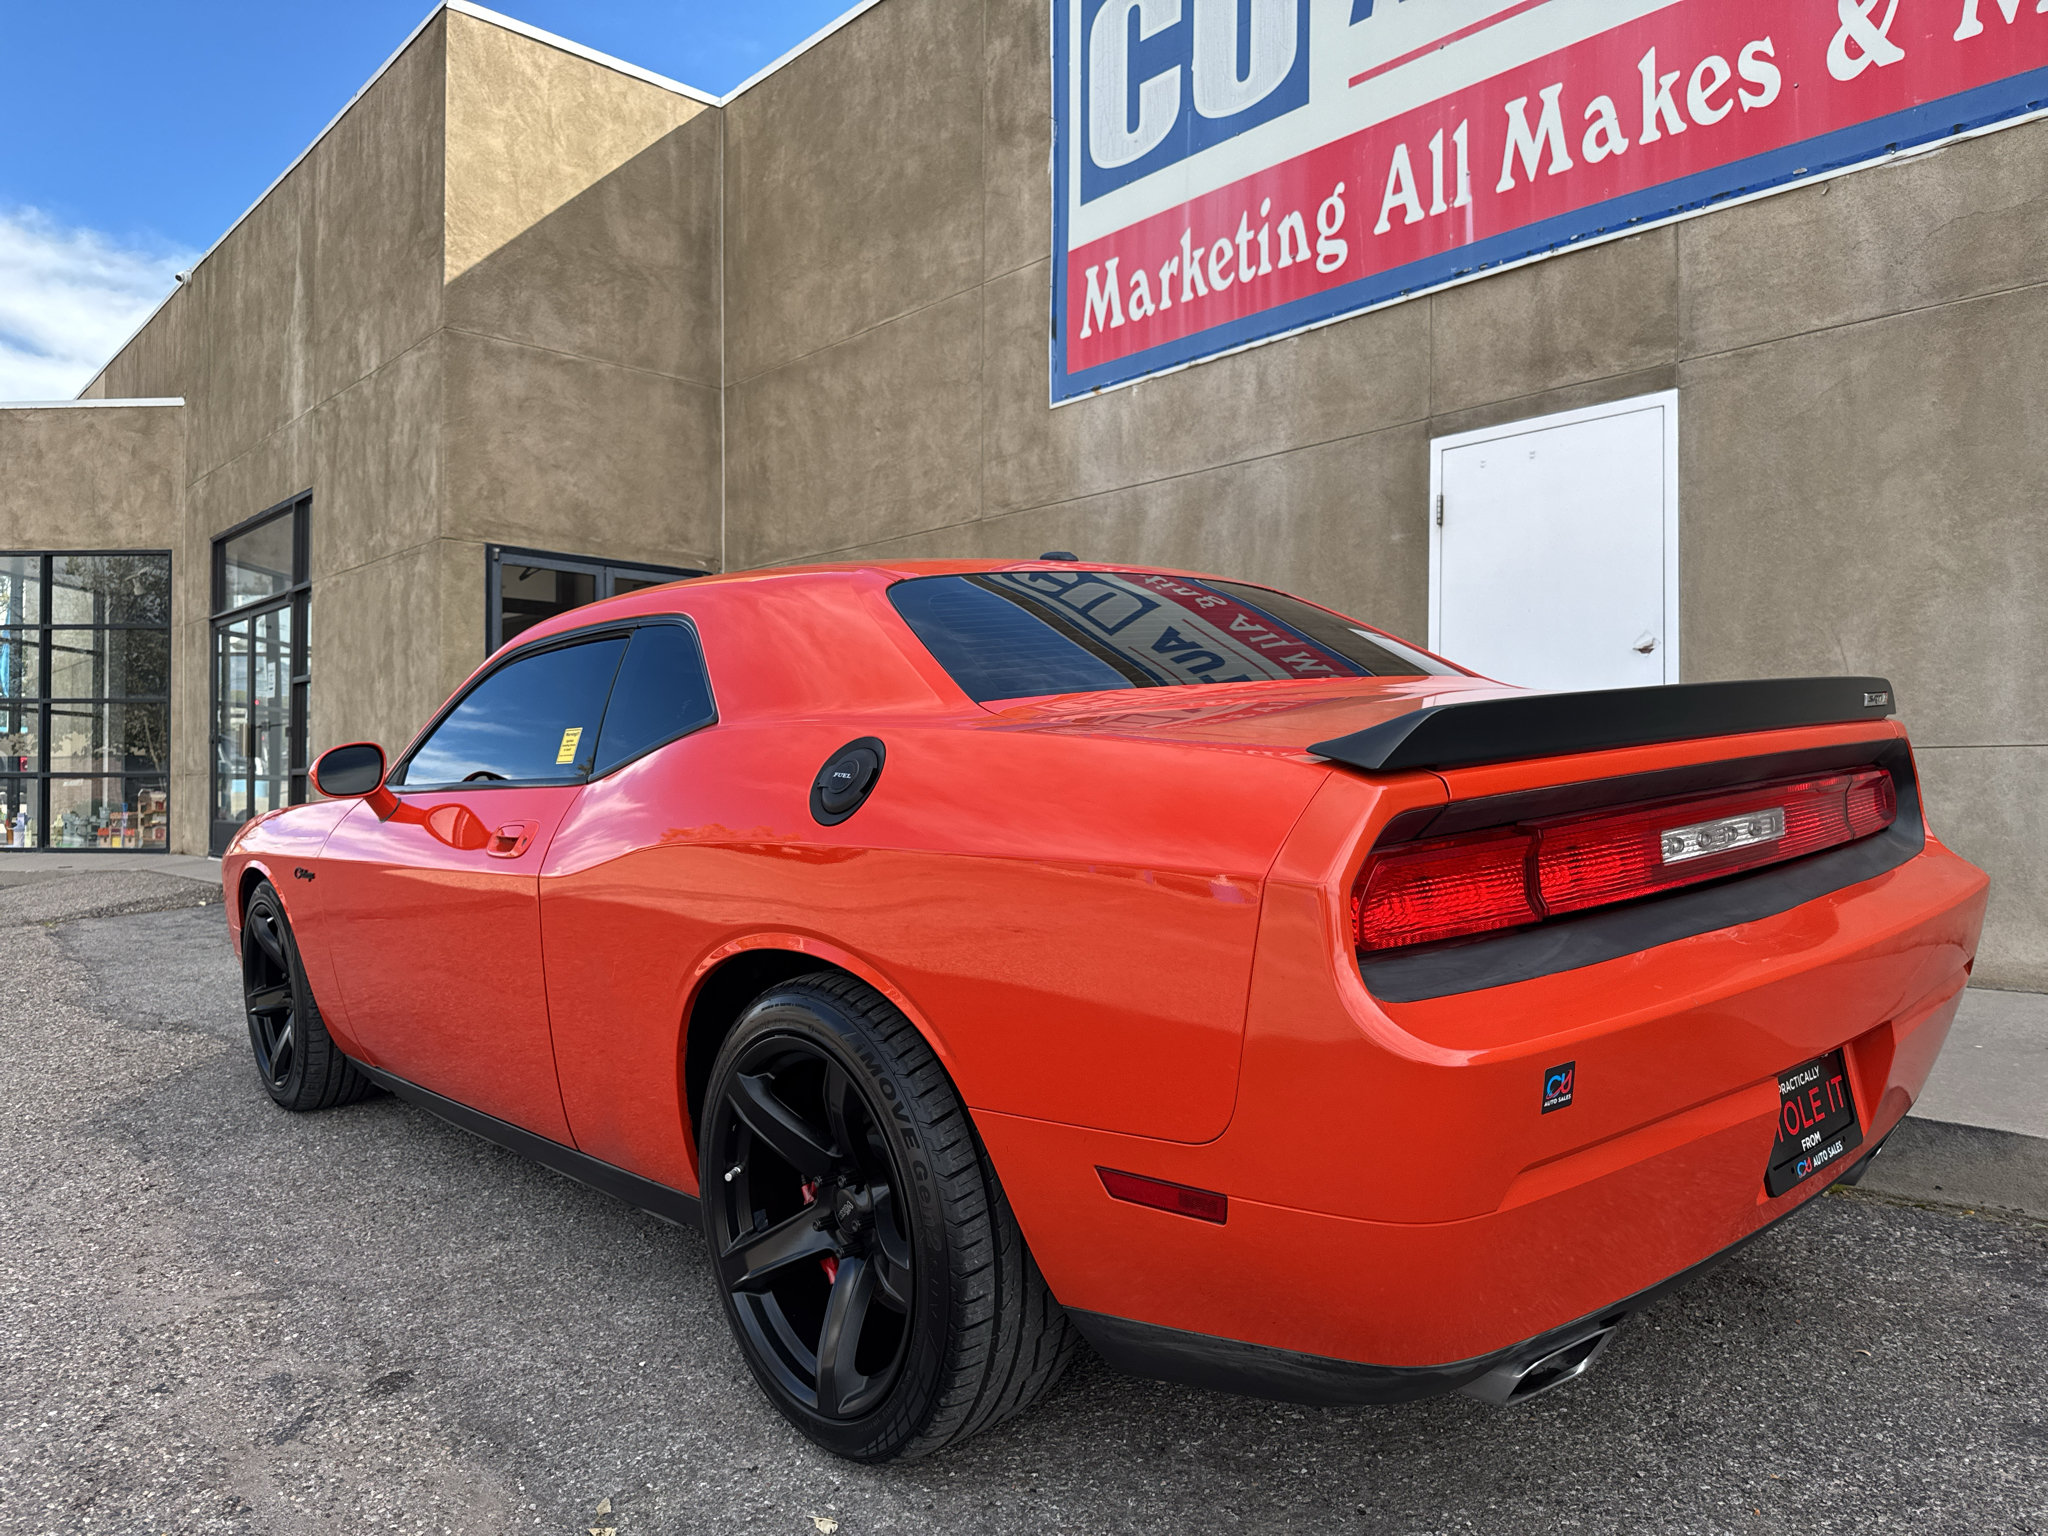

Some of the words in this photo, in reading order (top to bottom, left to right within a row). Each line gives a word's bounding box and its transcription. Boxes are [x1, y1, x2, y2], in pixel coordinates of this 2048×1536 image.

[1080, 182, 1347, 338] Marketing
[1374, 119, 1476, 235] All
[1496, 37, 1781, 193] Makes
[1827, 0, 1905, 81] &
[1544, 1098, 1558, 1107] AUTO
[1777, 1086, 1826, 1143] OLE
[1826, 1075, 1845, 1113] IT
[1801, 1131, 1822, 1151] FROM
[1813, 1150, 1828, 1167] AUTO
[1827, 1140, 1843, 1158] SALES
